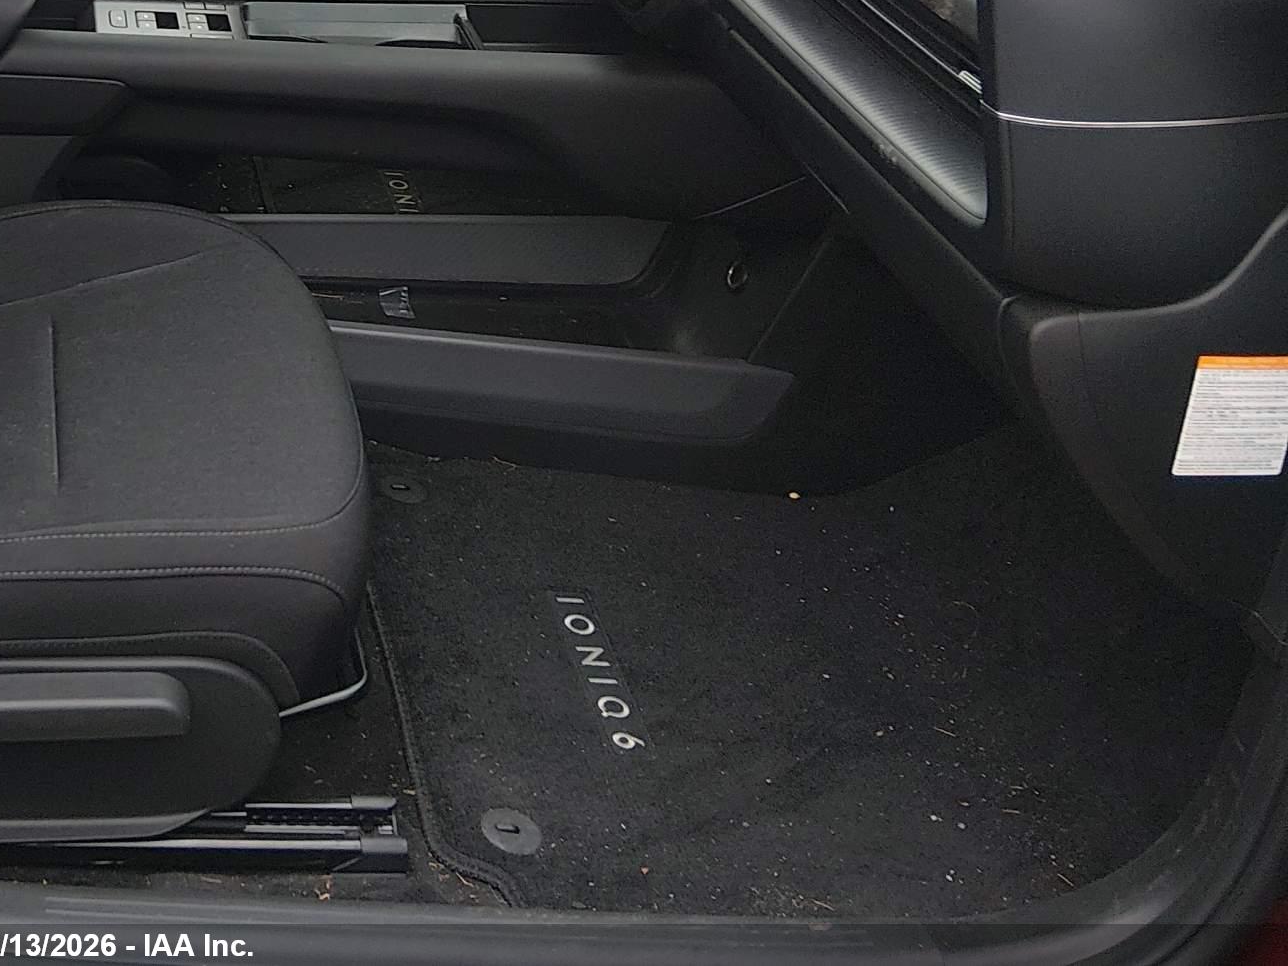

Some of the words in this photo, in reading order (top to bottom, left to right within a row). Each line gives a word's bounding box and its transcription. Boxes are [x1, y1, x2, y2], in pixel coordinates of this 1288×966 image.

[384, 171, 419, 213] IONI
[556, 596, 631, 719] IONIQ
[612, 732, 646, 750] 6
